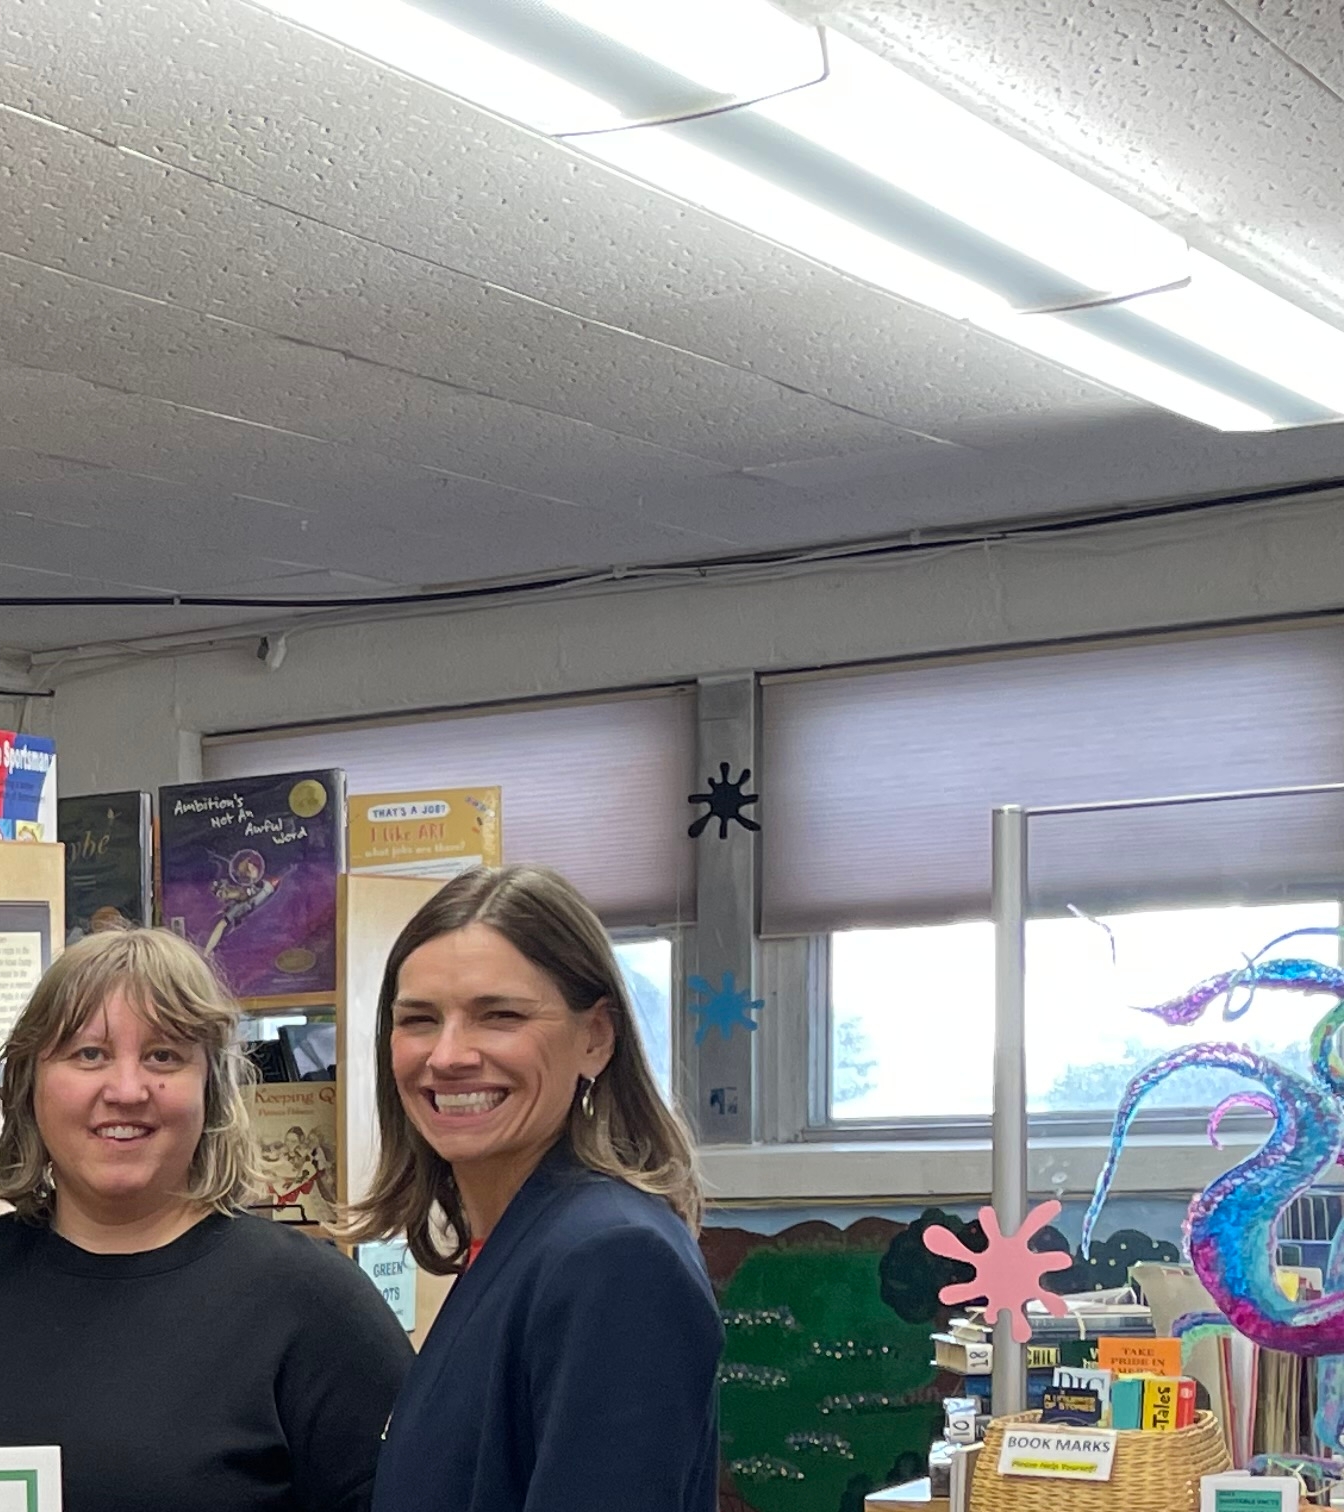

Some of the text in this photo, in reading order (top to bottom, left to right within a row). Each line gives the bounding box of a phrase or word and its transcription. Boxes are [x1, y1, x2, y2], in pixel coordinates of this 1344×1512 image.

[173, 794, 244, 816] Ambition's
[372, 806, 406, 818] THAT'S
[410, 806, 418, 815] A
[211, 809, 254, 828] Not An
[245, 819, 283, 838] Awful
[271, 827, 308, 845] Word
[381, 826, 411, 842] like
[416, 824, 446, 839] ART
[255, 1086, 336, 1105] Keeping Q
[373, 1261, 403, 1278] GREEN
[969, 1349, 988, 1368] 18
[1122, 1348, 1155, 1356] TAKE
[1111, 1357, 1148, 1366] PRIDE
[1007, 1436, 1111, 1454] BOOK MARKS
